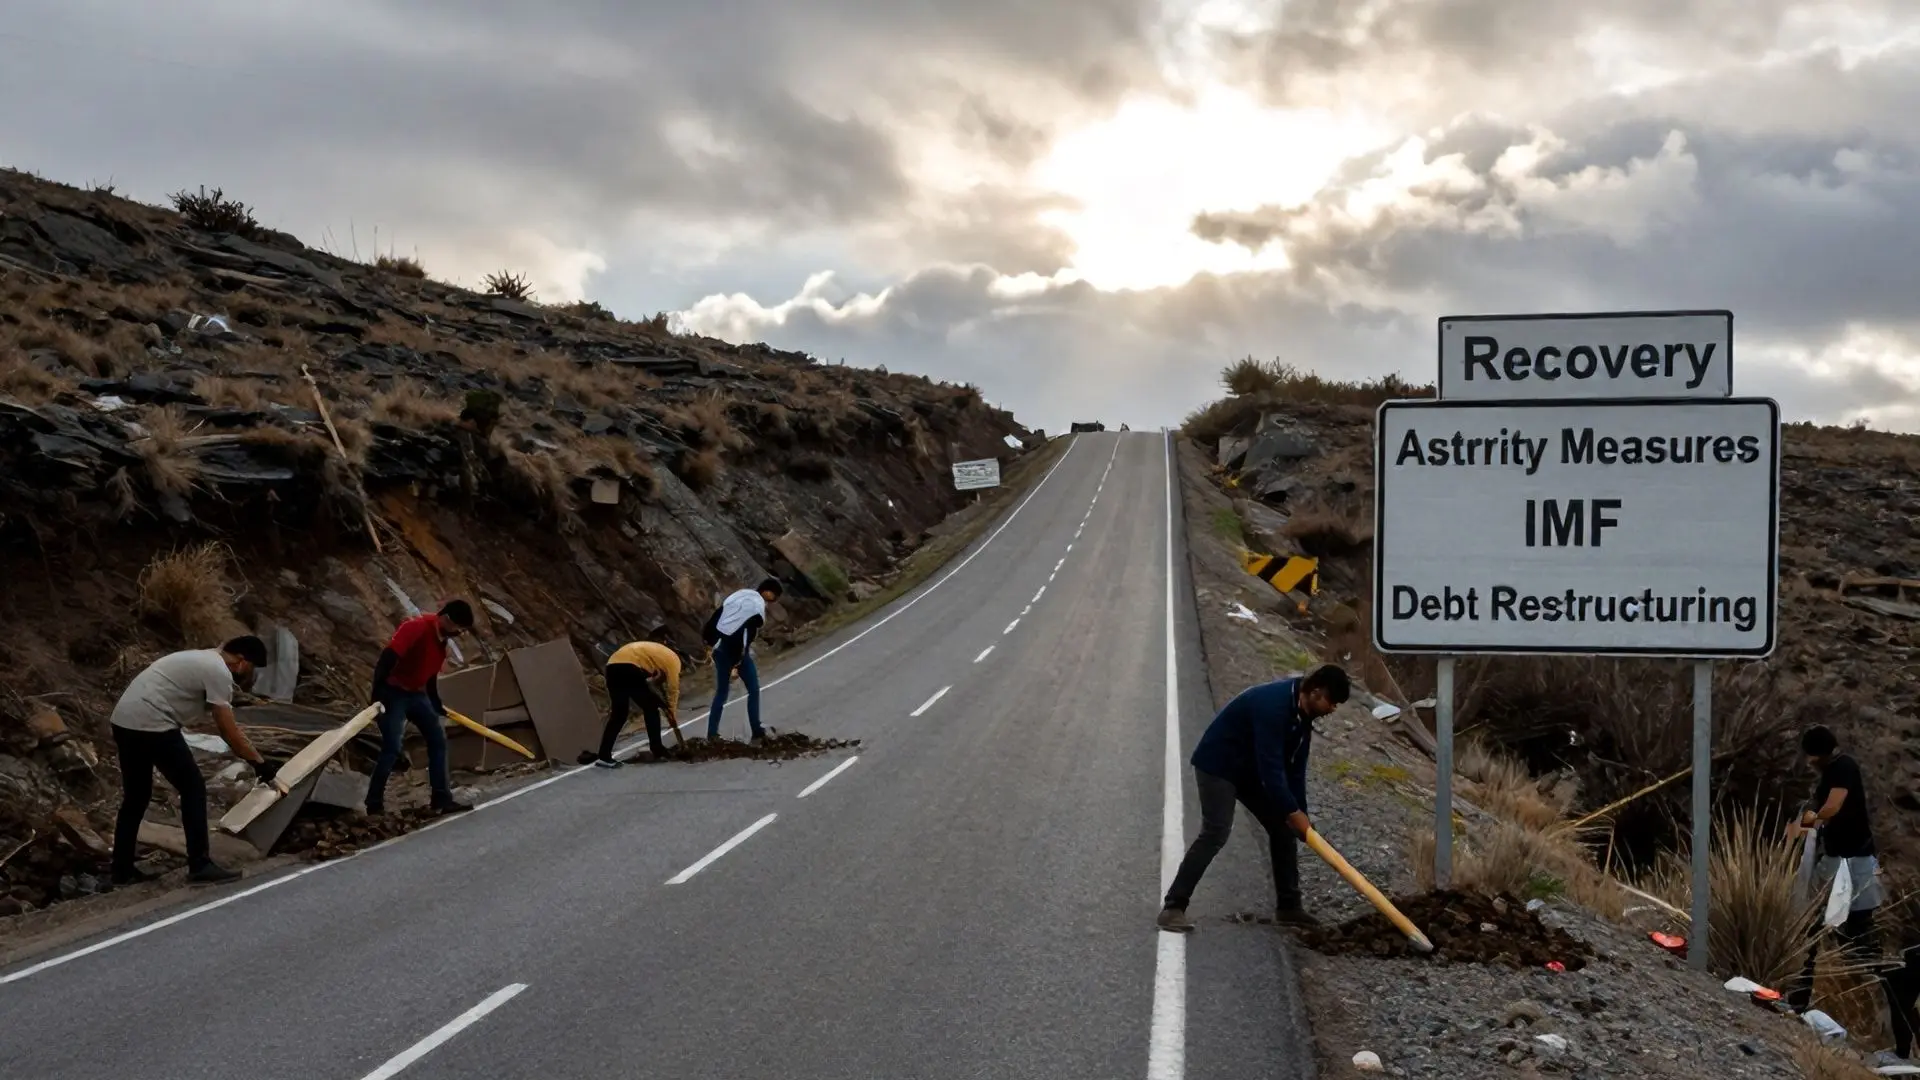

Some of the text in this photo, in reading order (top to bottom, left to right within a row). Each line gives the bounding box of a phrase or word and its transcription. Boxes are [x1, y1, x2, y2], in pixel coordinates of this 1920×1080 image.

[1465, 336, 1716, 389] Recovery
[1561, 428, 1760, 465] Measures
[1526, 499, 1622, 547] IMF
[1392, 585, 1757, 632] Debt Restructuring
